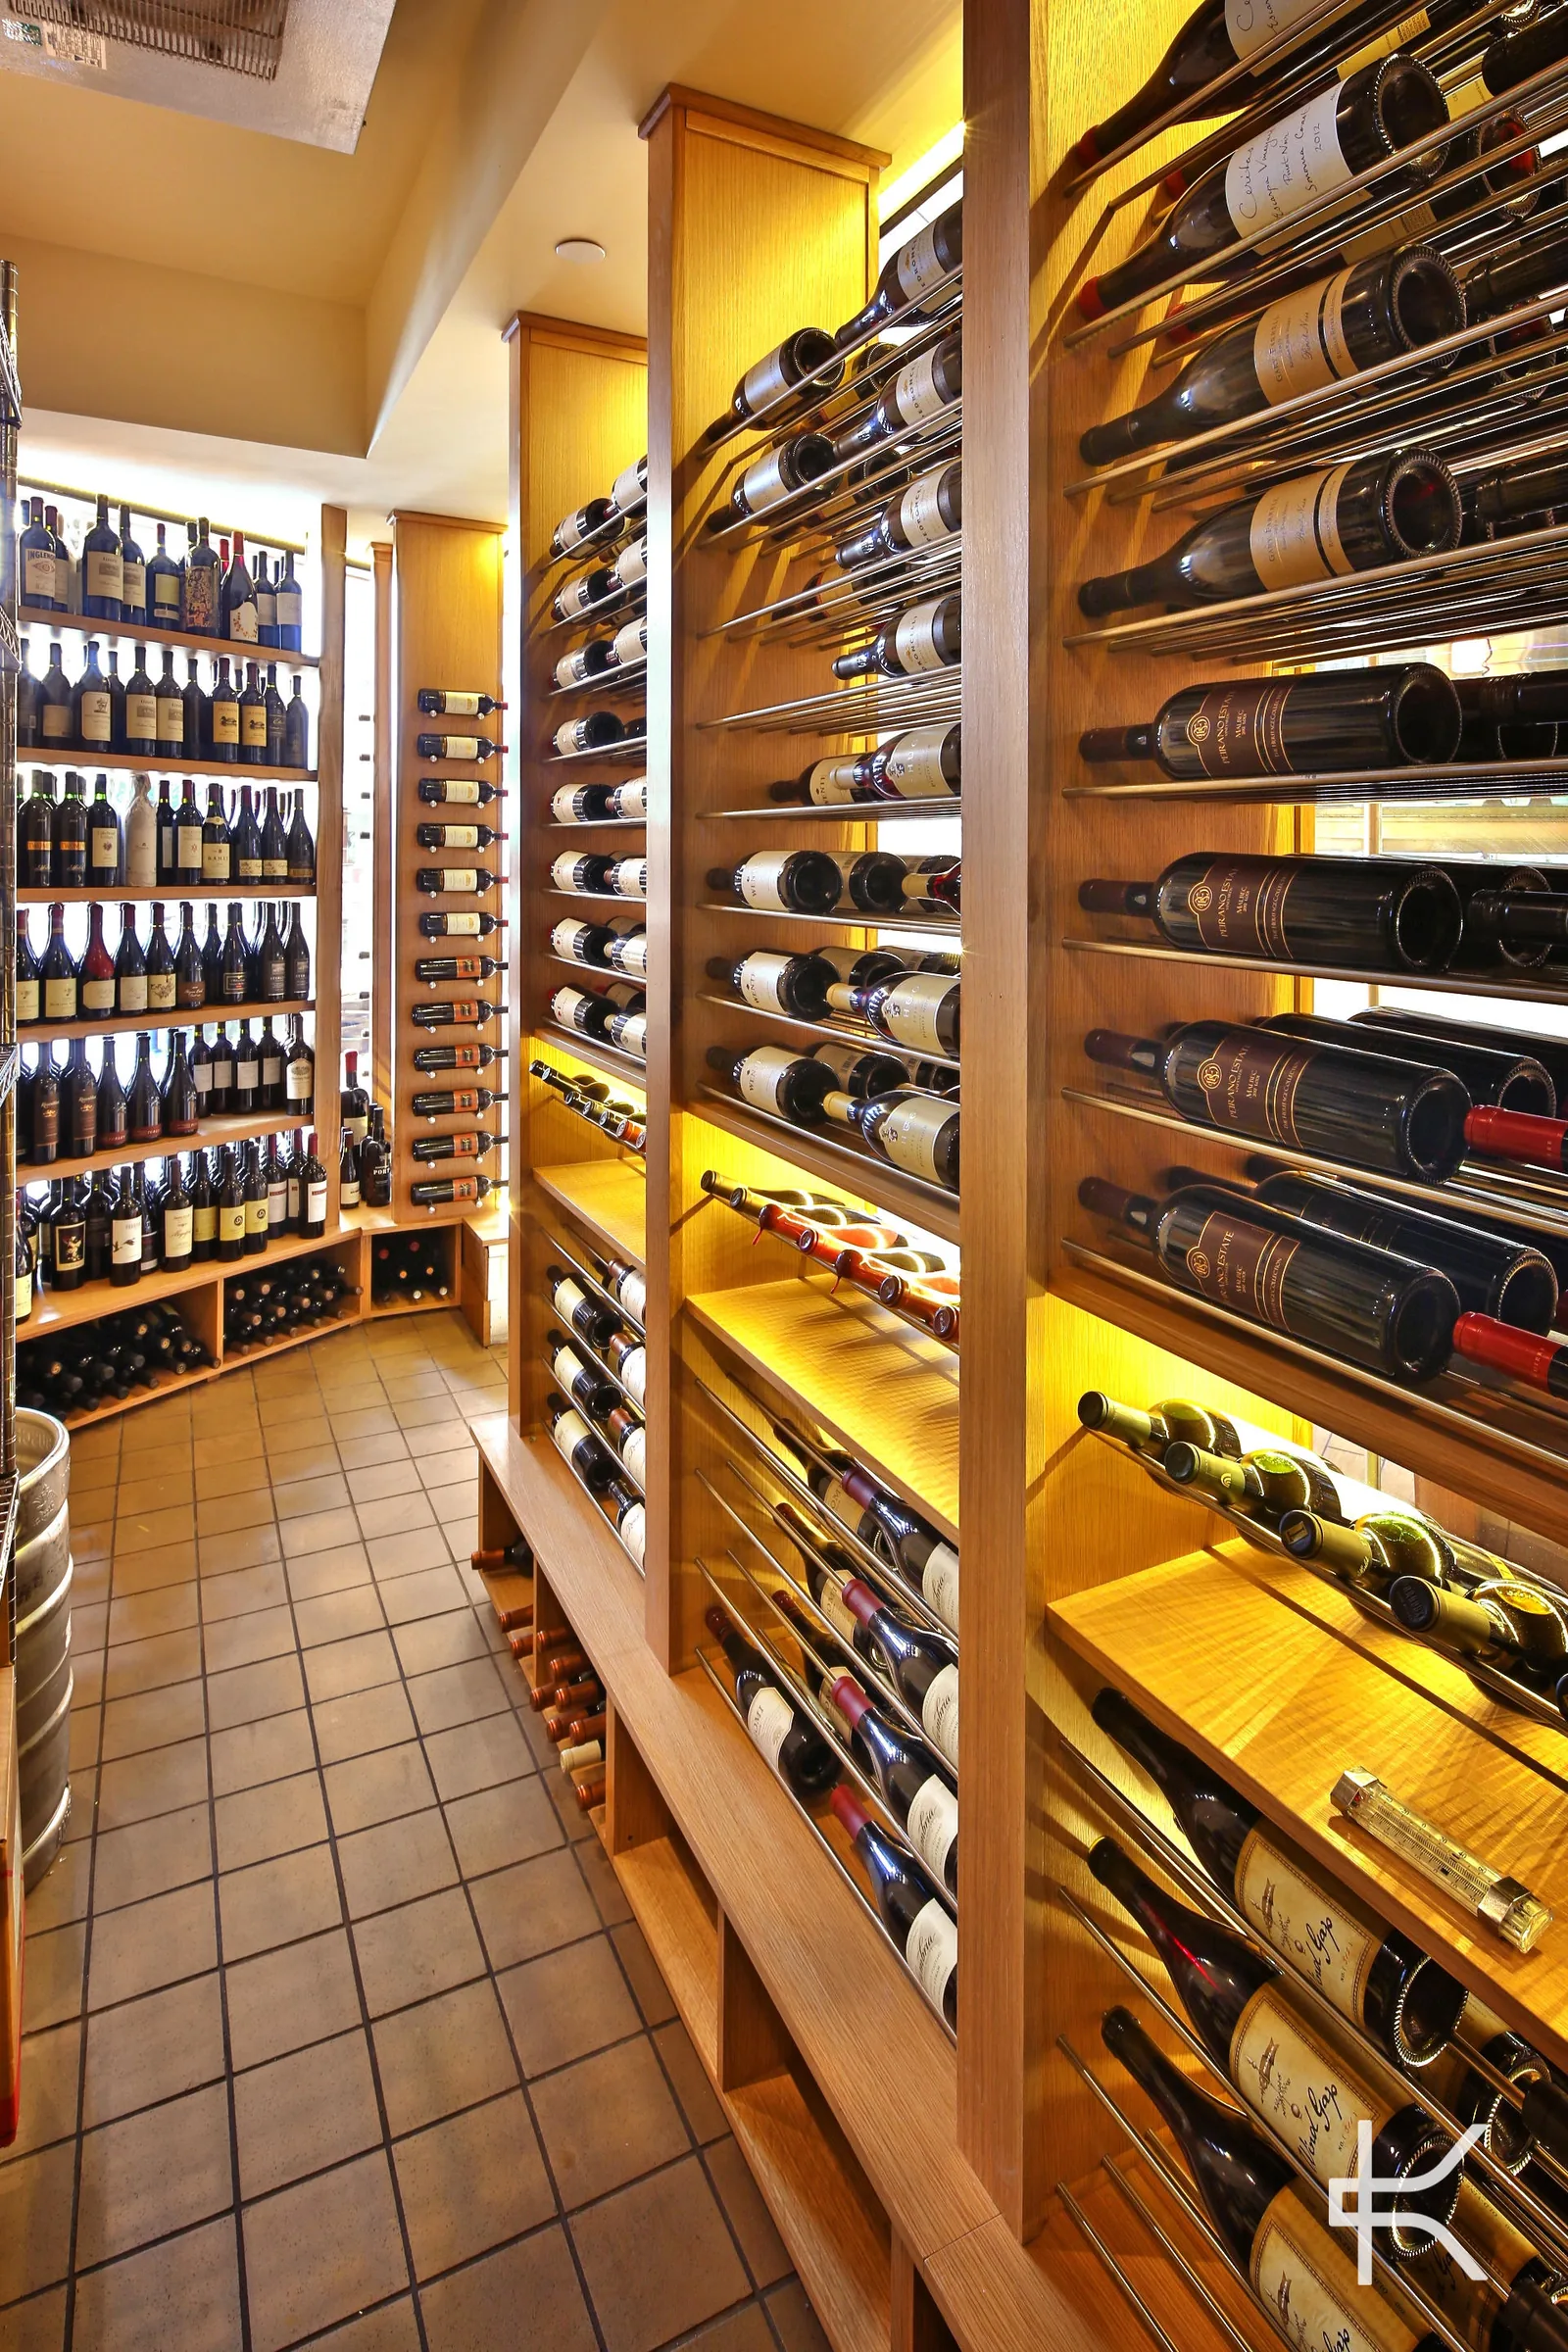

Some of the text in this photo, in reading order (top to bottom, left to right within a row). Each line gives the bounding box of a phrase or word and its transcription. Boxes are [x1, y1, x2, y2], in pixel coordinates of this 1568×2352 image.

[1313, 122, 1322, 152] 2012
[1300, 146, 1317, 192] Sonoma
[1268, 314, 1280, 355] FARRELL
[1272, 360, 1283, 382] GARY
[1265, 497, 1280, 563] GARY FARRELL
[1217, 720, 1230, 764] PEIRANO
[1235, 709, 1245, 738] MALBEC
[1217, 893, 1229, 938] PEIRANO
[1236, 886, 1249, 914] MALBEC
[1227, 1074, 1239, 1118] PEIRANO
[1246, 1069, 1257, 1099] MALBEC
[373, 1167, 390, 1176] PORT
[1217, 1230, 1235, 1266] ESTATE
[1235, 1264, 1244, 1293] MALBEC
[1305, 1916, 1341, 1966] Gap
[1307, 2083, 1343, 2132] Gap
